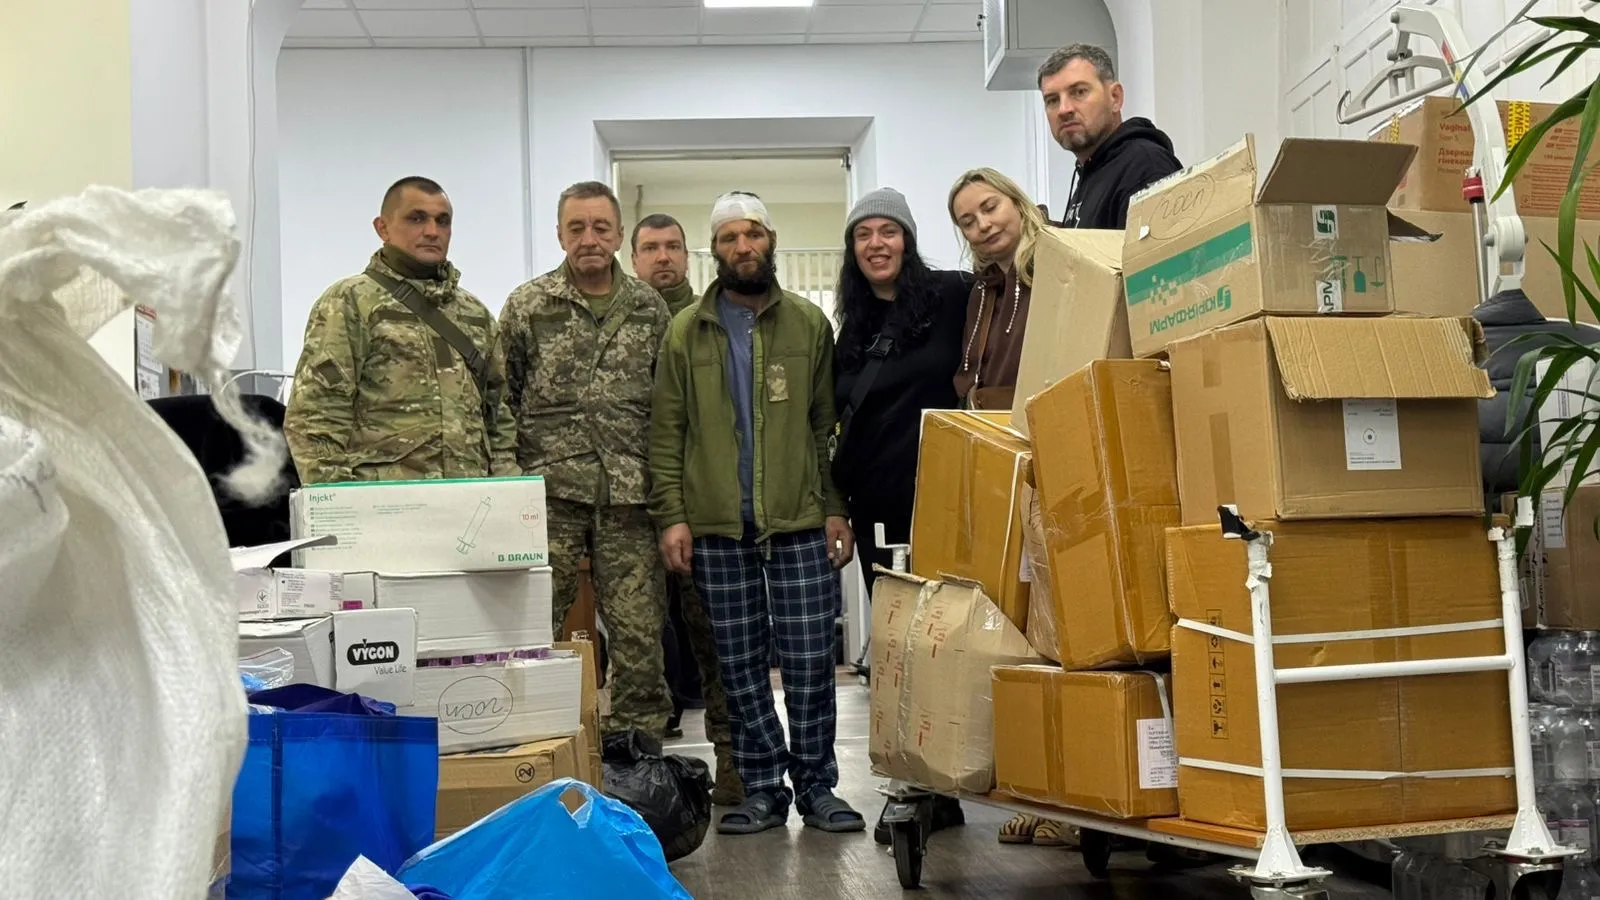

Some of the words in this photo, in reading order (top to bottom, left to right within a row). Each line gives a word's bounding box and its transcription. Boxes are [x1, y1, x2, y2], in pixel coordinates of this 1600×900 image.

[522, 513, 530, 521] 10
[498, 554, 505, 562] B
[508, 553, 543, 562] BRAUN
[352, 645, 395, 661] VYGON
